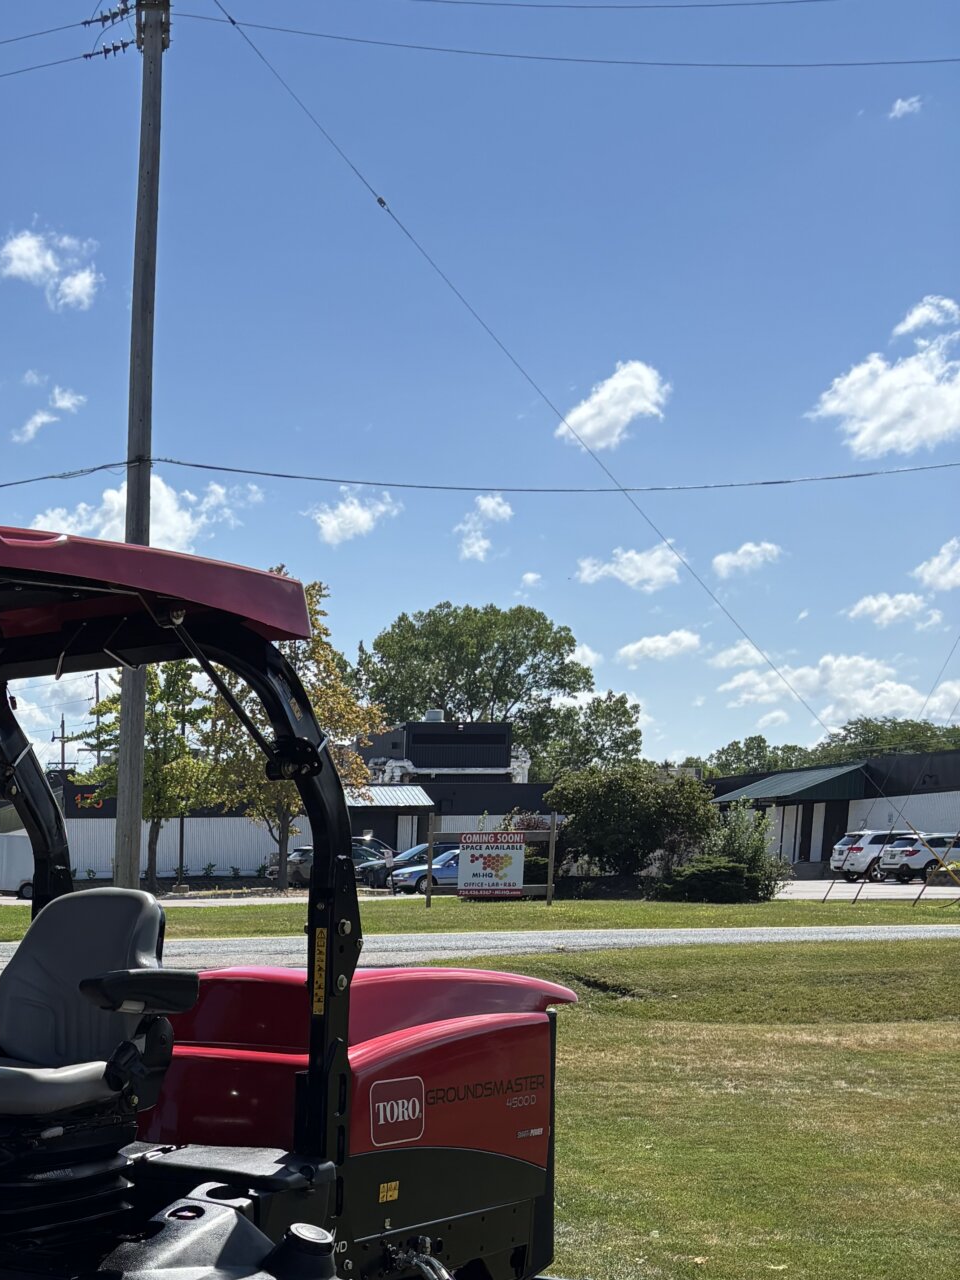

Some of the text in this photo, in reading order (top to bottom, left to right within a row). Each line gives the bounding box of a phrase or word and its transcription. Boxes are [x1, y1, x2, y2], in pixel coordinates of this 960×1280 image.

[461, 833, 524, 843] COMING SOON!
[425, 1075, 545, 1106] GROUNDSMASTER
[375, 1097, 420, 1125] TORO
